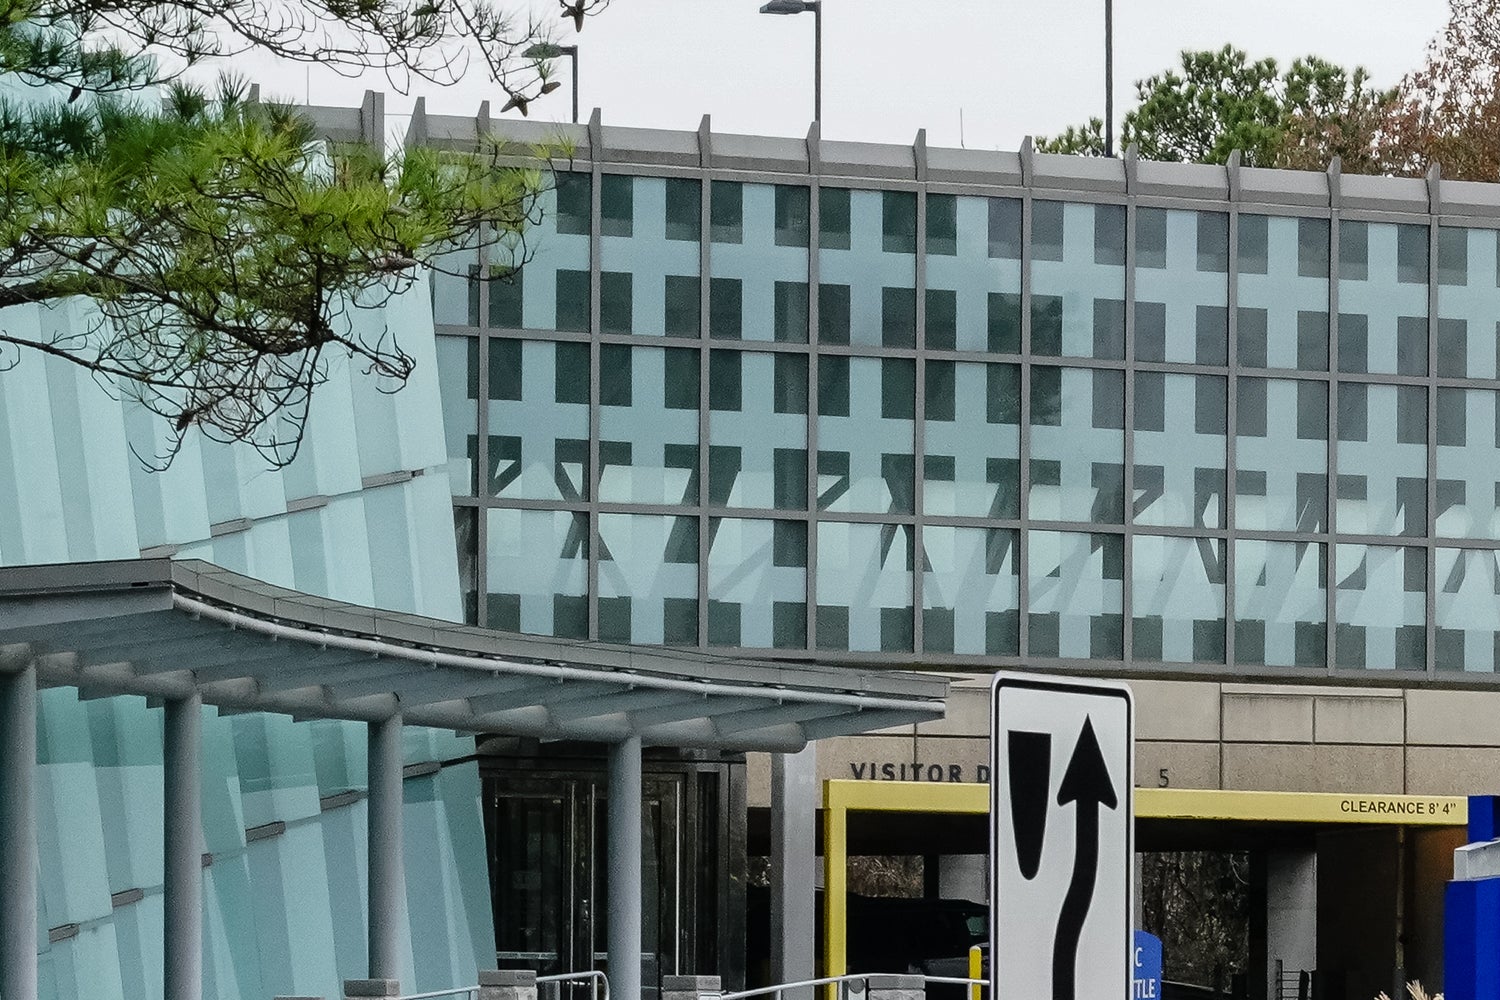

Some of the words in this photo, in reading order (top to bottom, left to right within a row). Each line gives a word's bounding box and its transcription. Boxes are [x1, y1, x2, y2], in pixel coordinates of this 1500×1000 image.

[850, 762, 962, 782] VISITOR
[1159, 769, 1169, 788] 5
[1340, 800, 1425, 814] CLEARANCE
